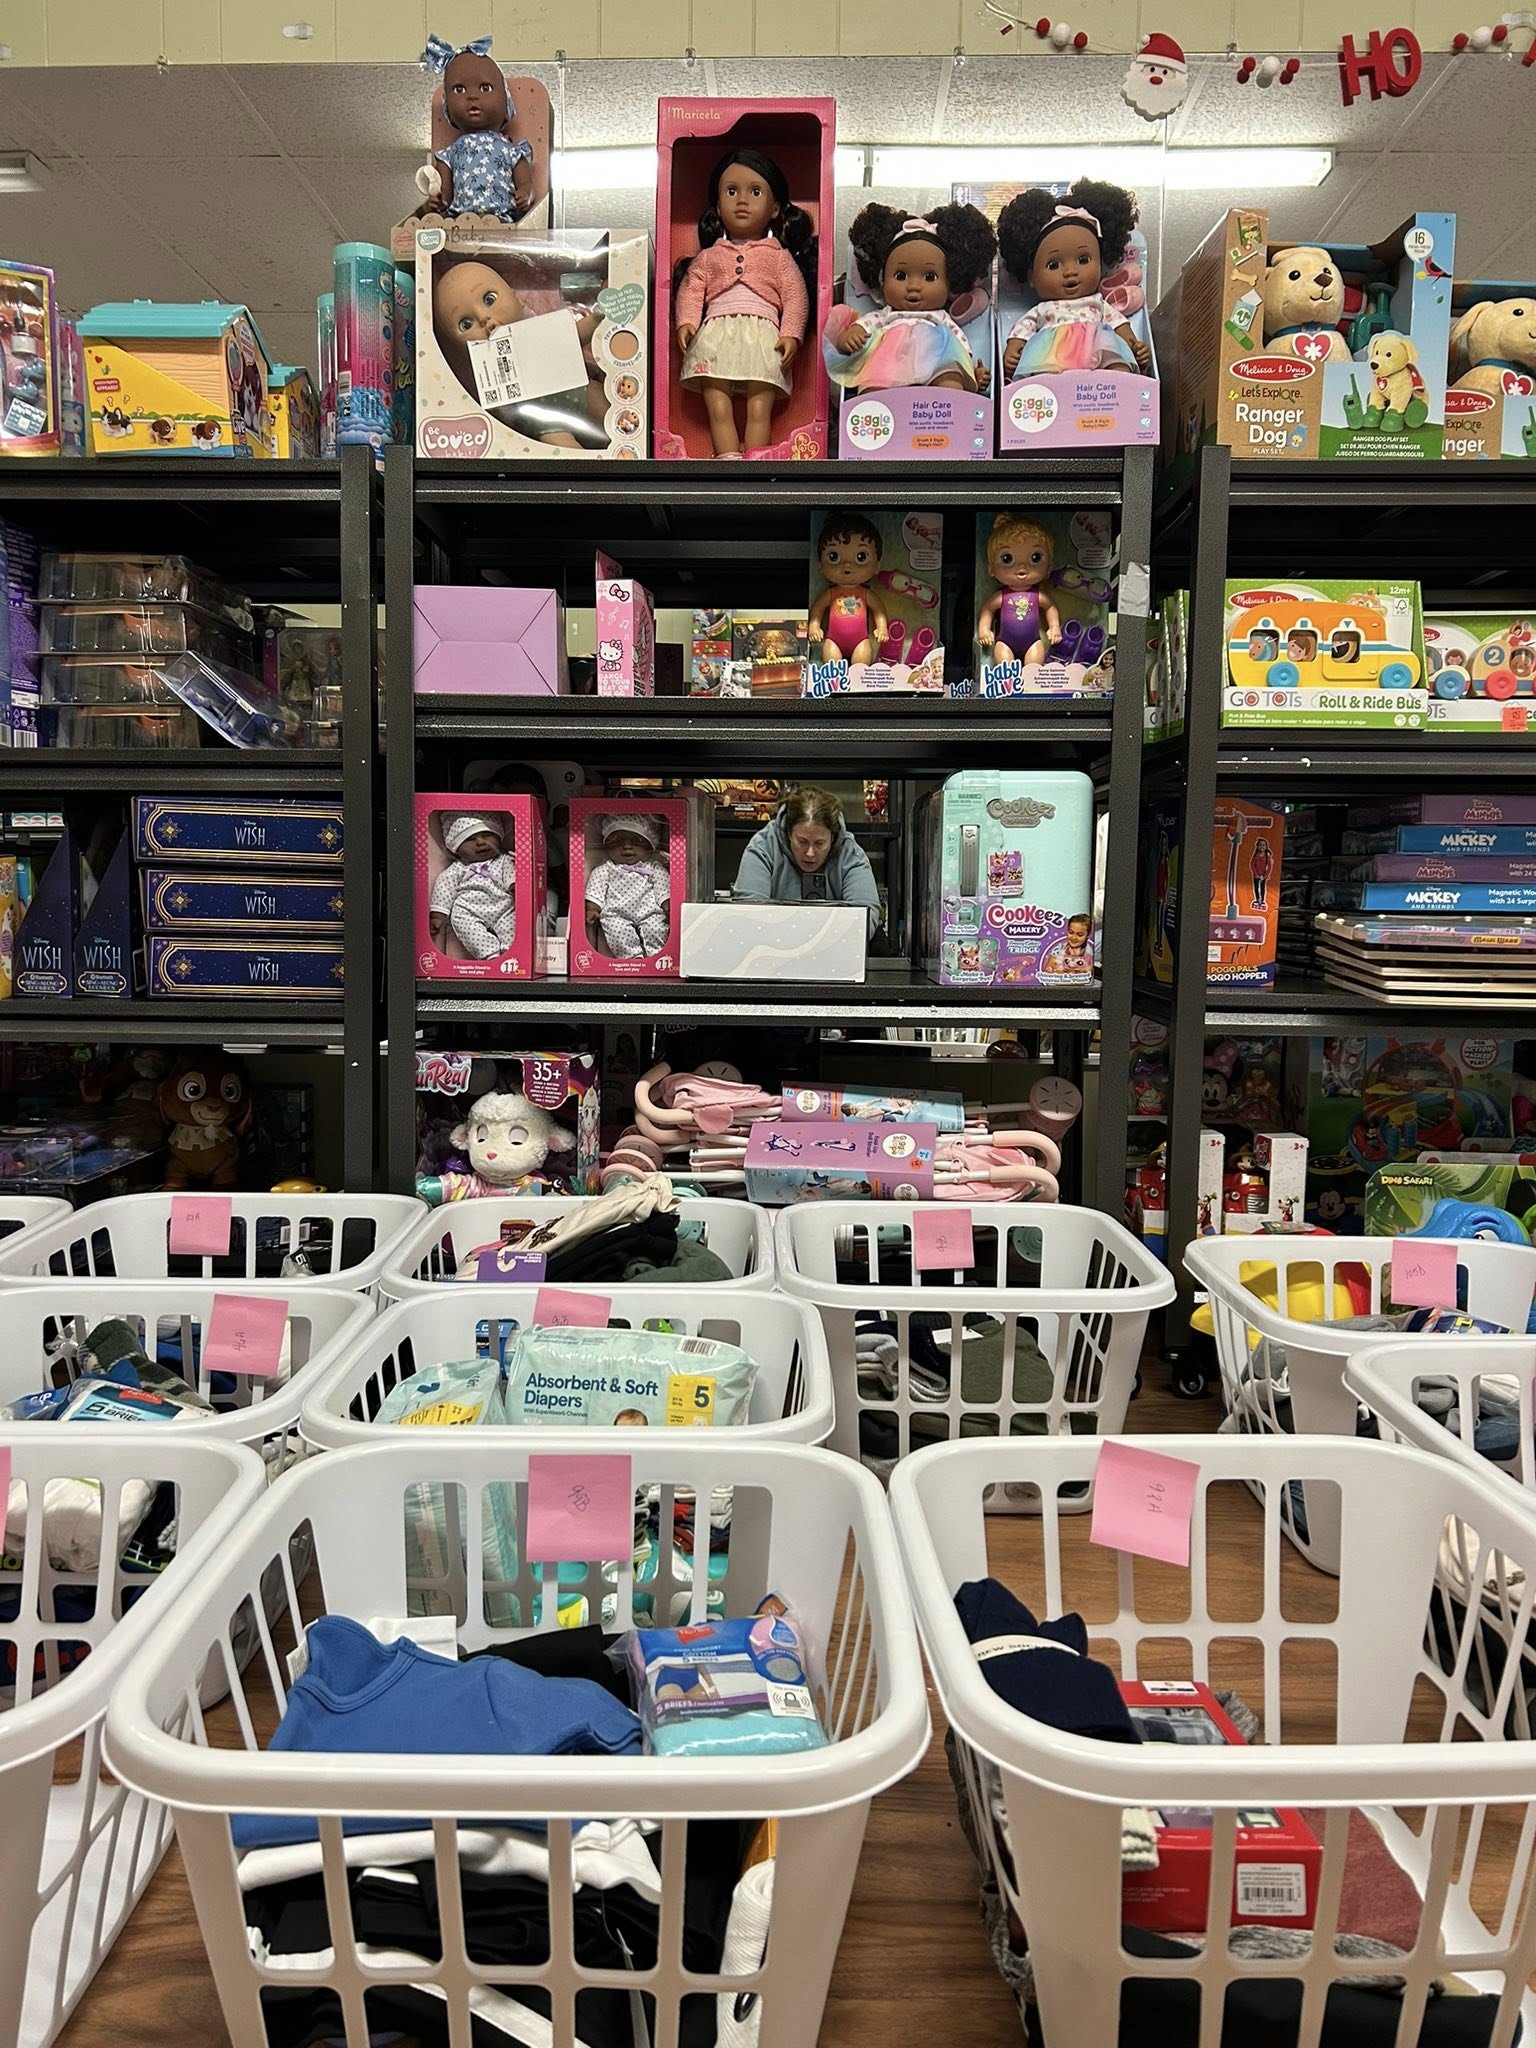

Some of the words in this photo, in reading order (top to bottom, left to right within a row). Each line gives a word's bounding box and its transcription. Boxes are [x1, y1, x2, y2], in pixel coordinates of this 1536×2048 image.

[1342, 27, 1422, 104] HO
[672, 107, 721, 119] Maricela
[1415, 231, 1425, 245] 16
[1238, 363, 1276, 376] Melissa
[1285, 364, 1306, 378] Doug
[1077, 384, 1093, 392] Hair
[1096, 383, 1116, 391] Care
[1241, 384, 1261, 398] Let's
[1262, 387, 1301, 402] Explore
[1012, 396, 1054, 411] Giggle
[1077, 392, 1097, 401] Baby
[1100, 391, 1117, 400] Doll
[1467, 397, 1488, 410] Doug
[913, 401, 929, 409] Hair
[931, 401, 952, 409] Care
[850, 413, 891, 428] Giggle
[912, 410, 933, 420] Baby
[935, 410, 952, 418] Doll
[1235, 403, 1304, 428] Ranger
[427, 426, 440, 436] Be
[1446, 419, 1482, 433] Explore
[425, 429, 488, 450] Loved
[1249, 424, 1288, 449] Dog
[1445, 438, 1485, 456] nger
[1236, 594, 1269, 605] Melissa
[1488, 649, 1500, 664] 2
[812, 660, 846, 683] baby
[984, 661, 1020, 684] baby
[1230, 690, 1260, 708] GO
[1319, 695, 1347, 709] Roll
[1349, 696, 1361, 709] &
[1363, 695, 1393, 709] Ride
[1396, 696, 1422, 709] Bus
[234, 826, 266, 846] WISH
[1440, 834, 1498, 846] MICKEY
[1405, 891, 1461, 904] MICKEY
[1488, 888, 1521, 896] Magnetic
[245, 895, 276, 915] WISH
[1008, 926, 1042, 934] MAKERY
[22, 945, 62, 970] WISH
[83, 945, 121, 969] WISH
[248, 962, 279, 981] WISH
[1231, 972, 1268, 980] HOPPER
[416, 1060, 469, 1092] urReal
[532, 1061, 562, 1081] 35+
[1210, 1139, 1221, 1147] 3+
[1381, 1175, 1402, 1185] DINO
[1403, 1176, 1433, 1185] SAFARI
[525, 1372, 607, 1392] Absorbent
[609, 1376, 621, 1393] &
[625, 1379, 659, 1397] Soft
[524, 1389, 583, 1408] Diapers
[694, 1385, 710, 1408] 5
[86, 1401, 109, 1412] 6
